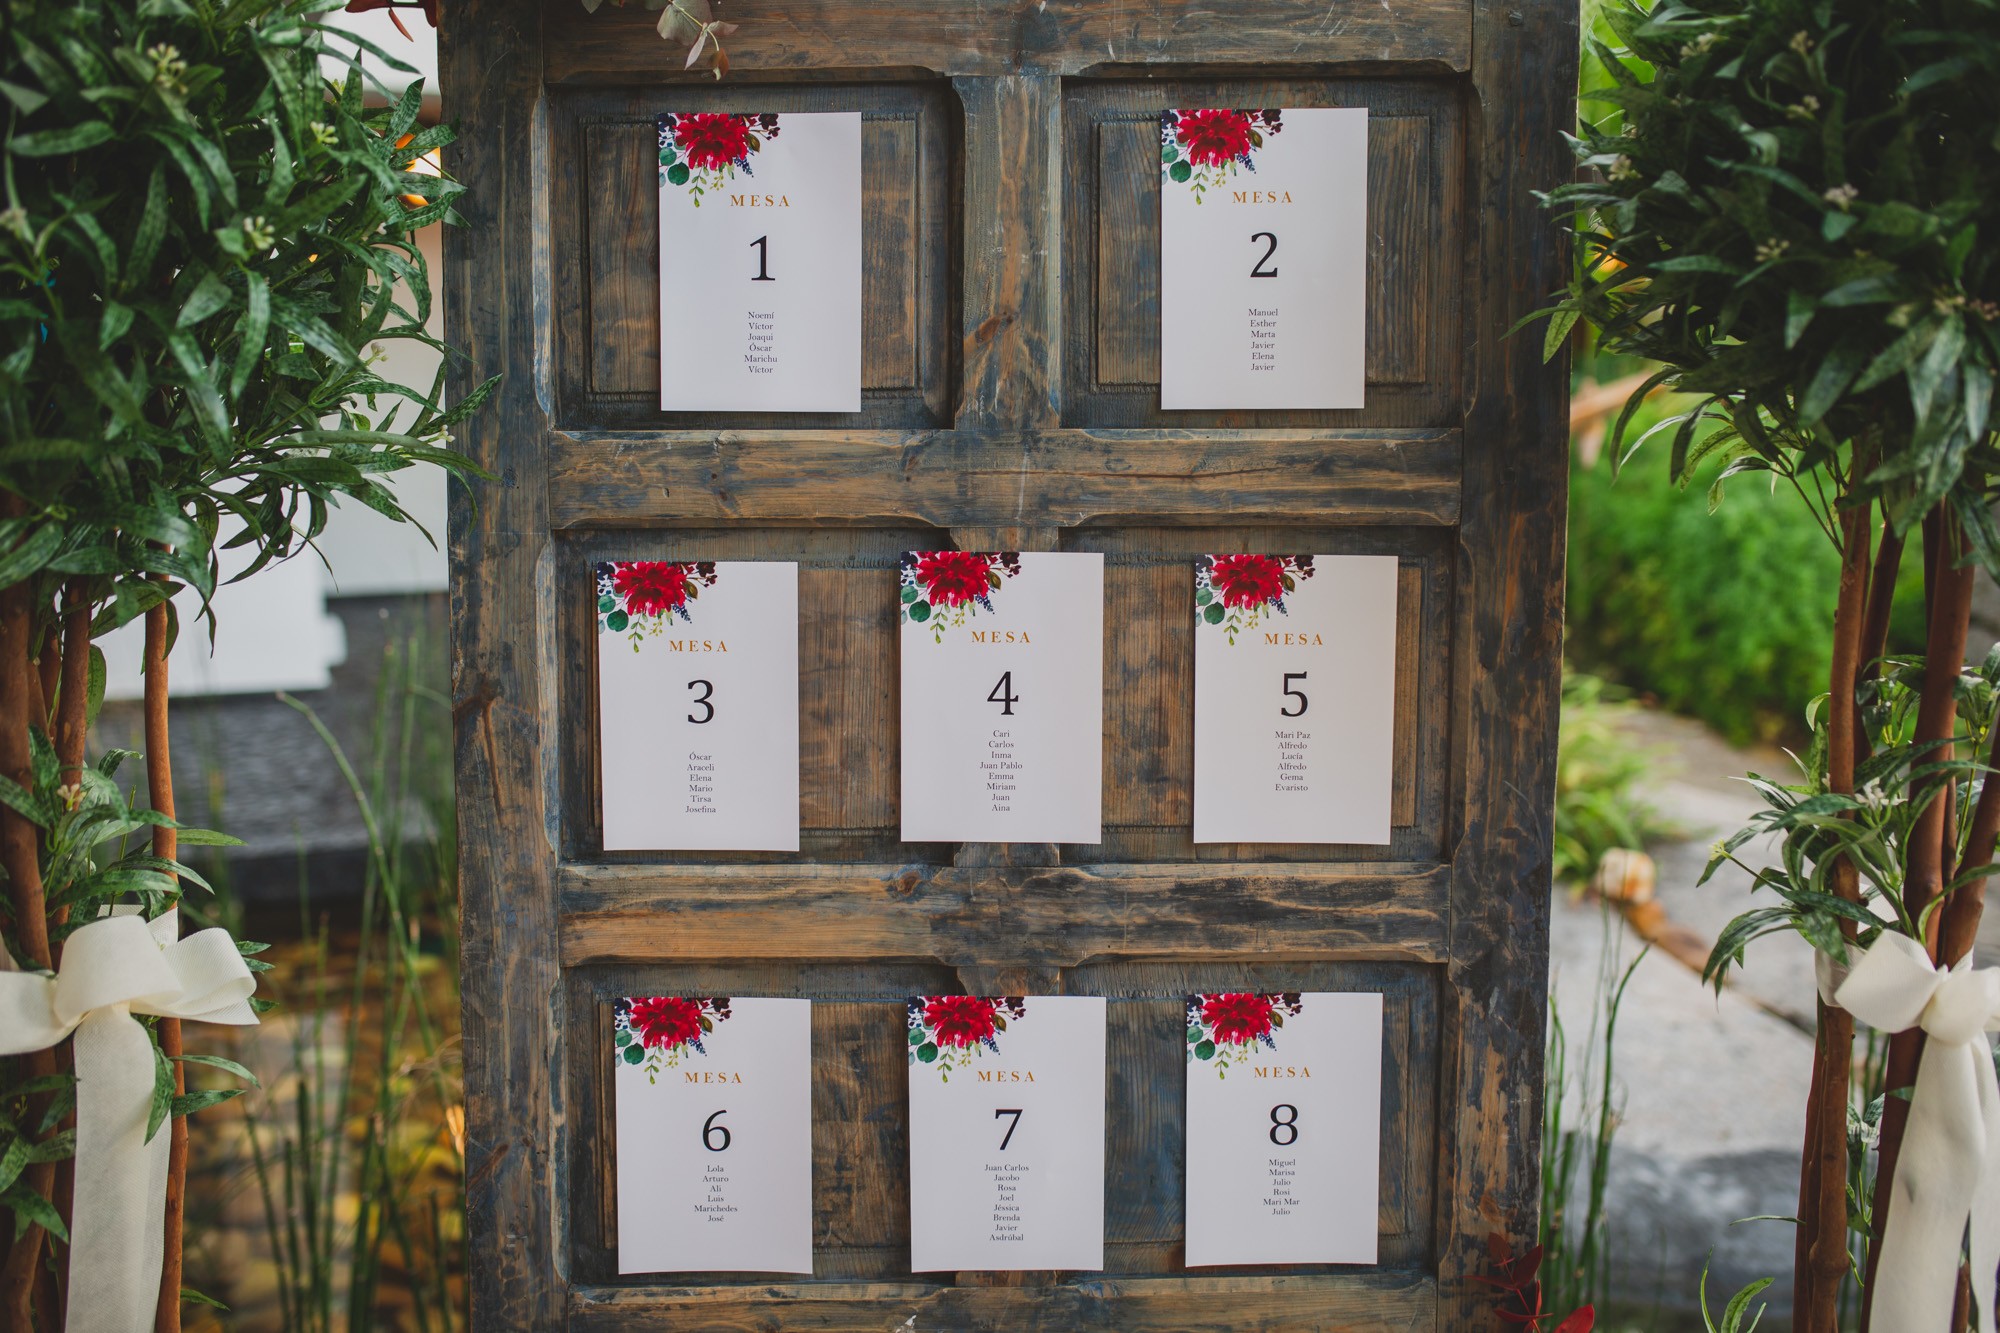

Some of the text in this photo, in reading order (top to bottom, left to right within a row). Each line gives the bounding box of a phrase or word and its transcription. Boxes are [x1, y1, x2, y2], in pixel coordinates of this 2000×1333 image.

[730, 195, 789, 207] MESA
[1232, 191, 1292, 203] MESA
[750, 235, 775, 281] 1
[1250, 232, 1278, 278] 2
[748, 311, 774, 319] Noemí
[1248, 308, 1278, 316] Manuel
[748, 322, 774, 330] Víctor
[1250, 319, 1276, 327] Esther
[748, 333, 773, 342] Joaqui
[1251, 330, 1275, 338] Marta
[749, 343, 772, 351] Óscar
[1251, 341, 1275, 349] Javier
[1252, 352, 1274, 360] Elena
[748, 365, 773, 373] Víctor
[1251, 363, 1275, 371] Javier
[971, 631, 1030, 643] MESA
[1265, 633, 1323, 645] MESA
[669, 640, 727, 652] MESA
[987, 671, 1019, 715] 4
[1281, 671, 1308, 717] 5
[688, 679, 714, 724] 3
[993, 729, 1010, 737] Cari
[988, 740, 1014, 748] Carlos
[689, 751, 712, 760] Óscar
[1281, 752, 1303, 760] Lucía
[1000, 761, 1022, 769] Pablo
[989, 772, 1014, 780] Emma
[689, 784, 712, 792] Mario
[987, 782, 1016, 790] Miriam
[685, 805, 716, 813] Josefina
[978, 1071, 1034, 1082] MESA
[1255, 1067, 1311, 1078] MESA
[685, 1072, 742, 1083] MESA
[1269, 1104, 1298, 1146] 8
[702, 1110, 731, 1152] 6
[995, 1109, 1023, 1151] 7
[1269, 1159, 1296, 1168] Miguel
